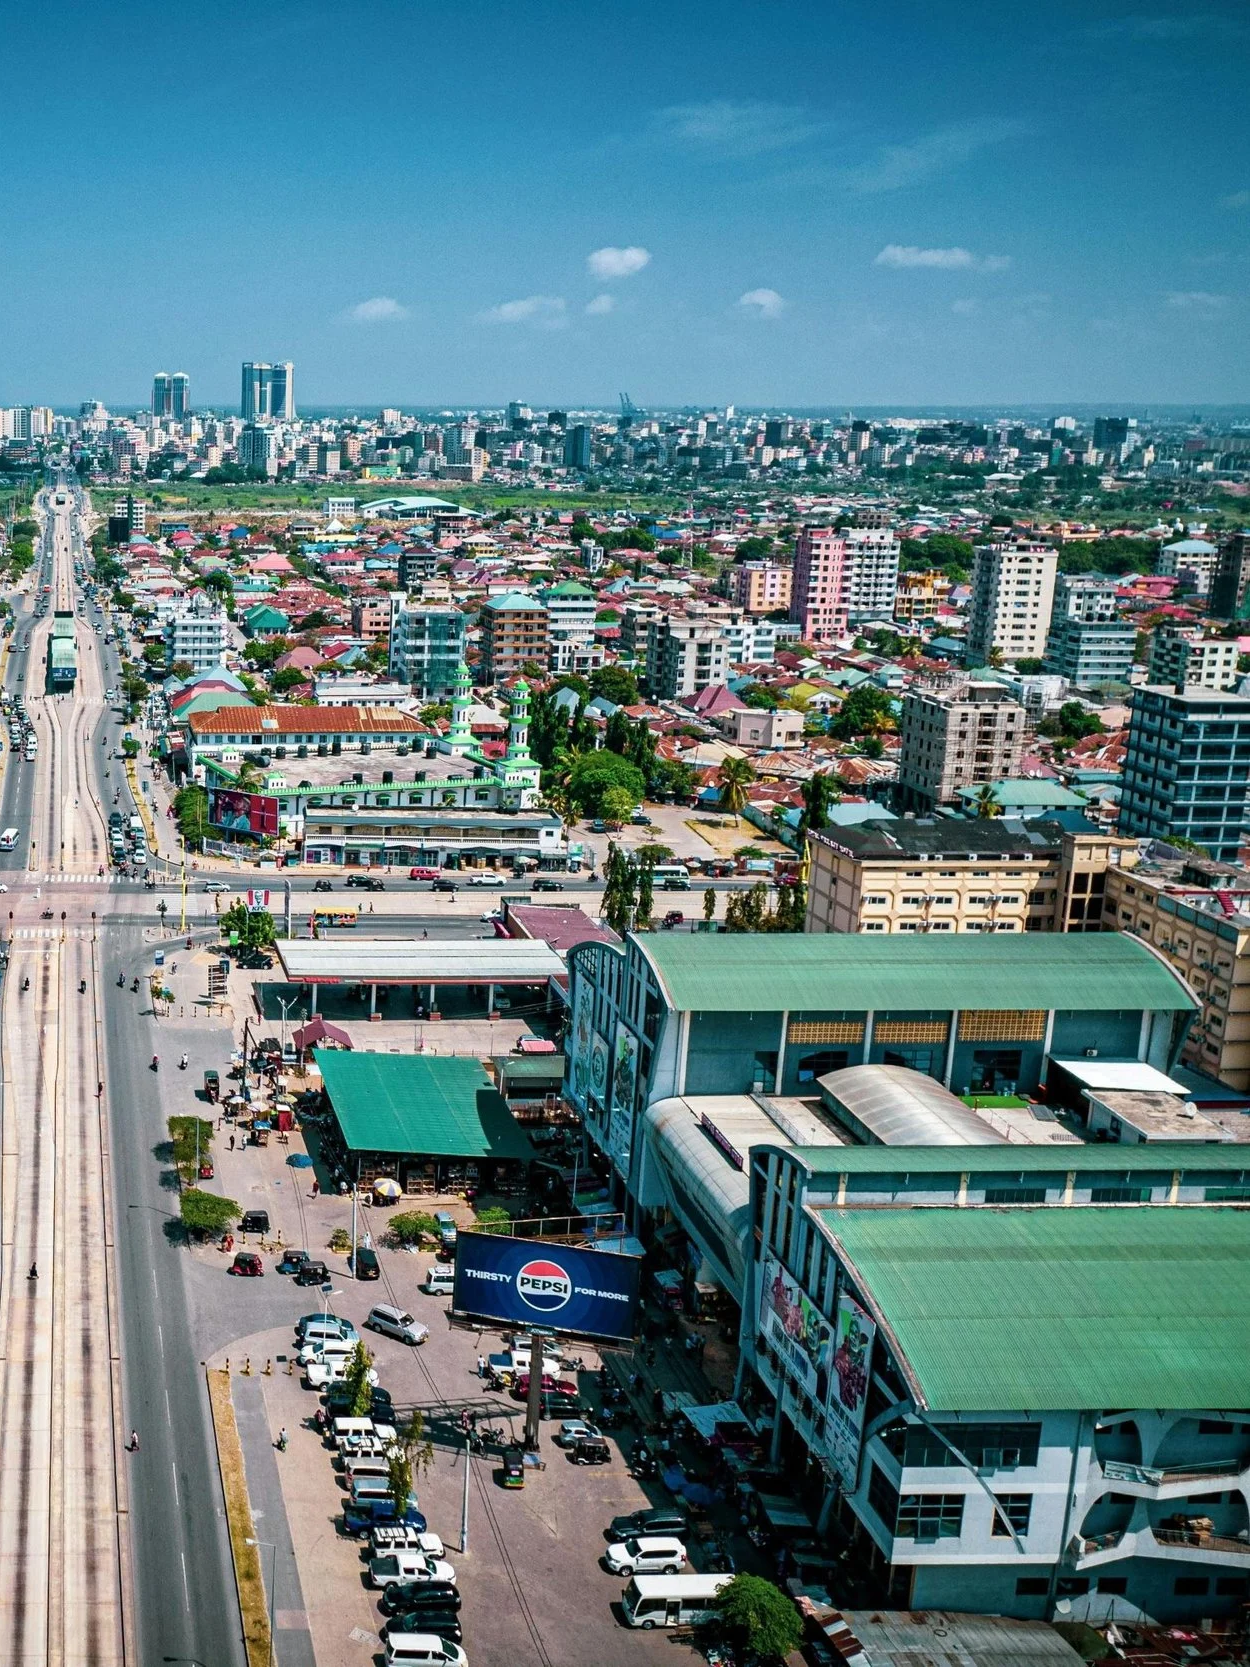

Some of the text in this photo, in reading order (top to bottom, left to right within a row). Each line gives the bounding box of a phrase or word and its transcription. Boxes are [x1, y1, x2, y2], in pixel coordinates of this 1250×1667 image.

[465, 1268, 512, 1283] THIRSTY
[520, 1276, 568, 1294] PEPSI
[574, 1286, 629, 1302] FOR MORE
